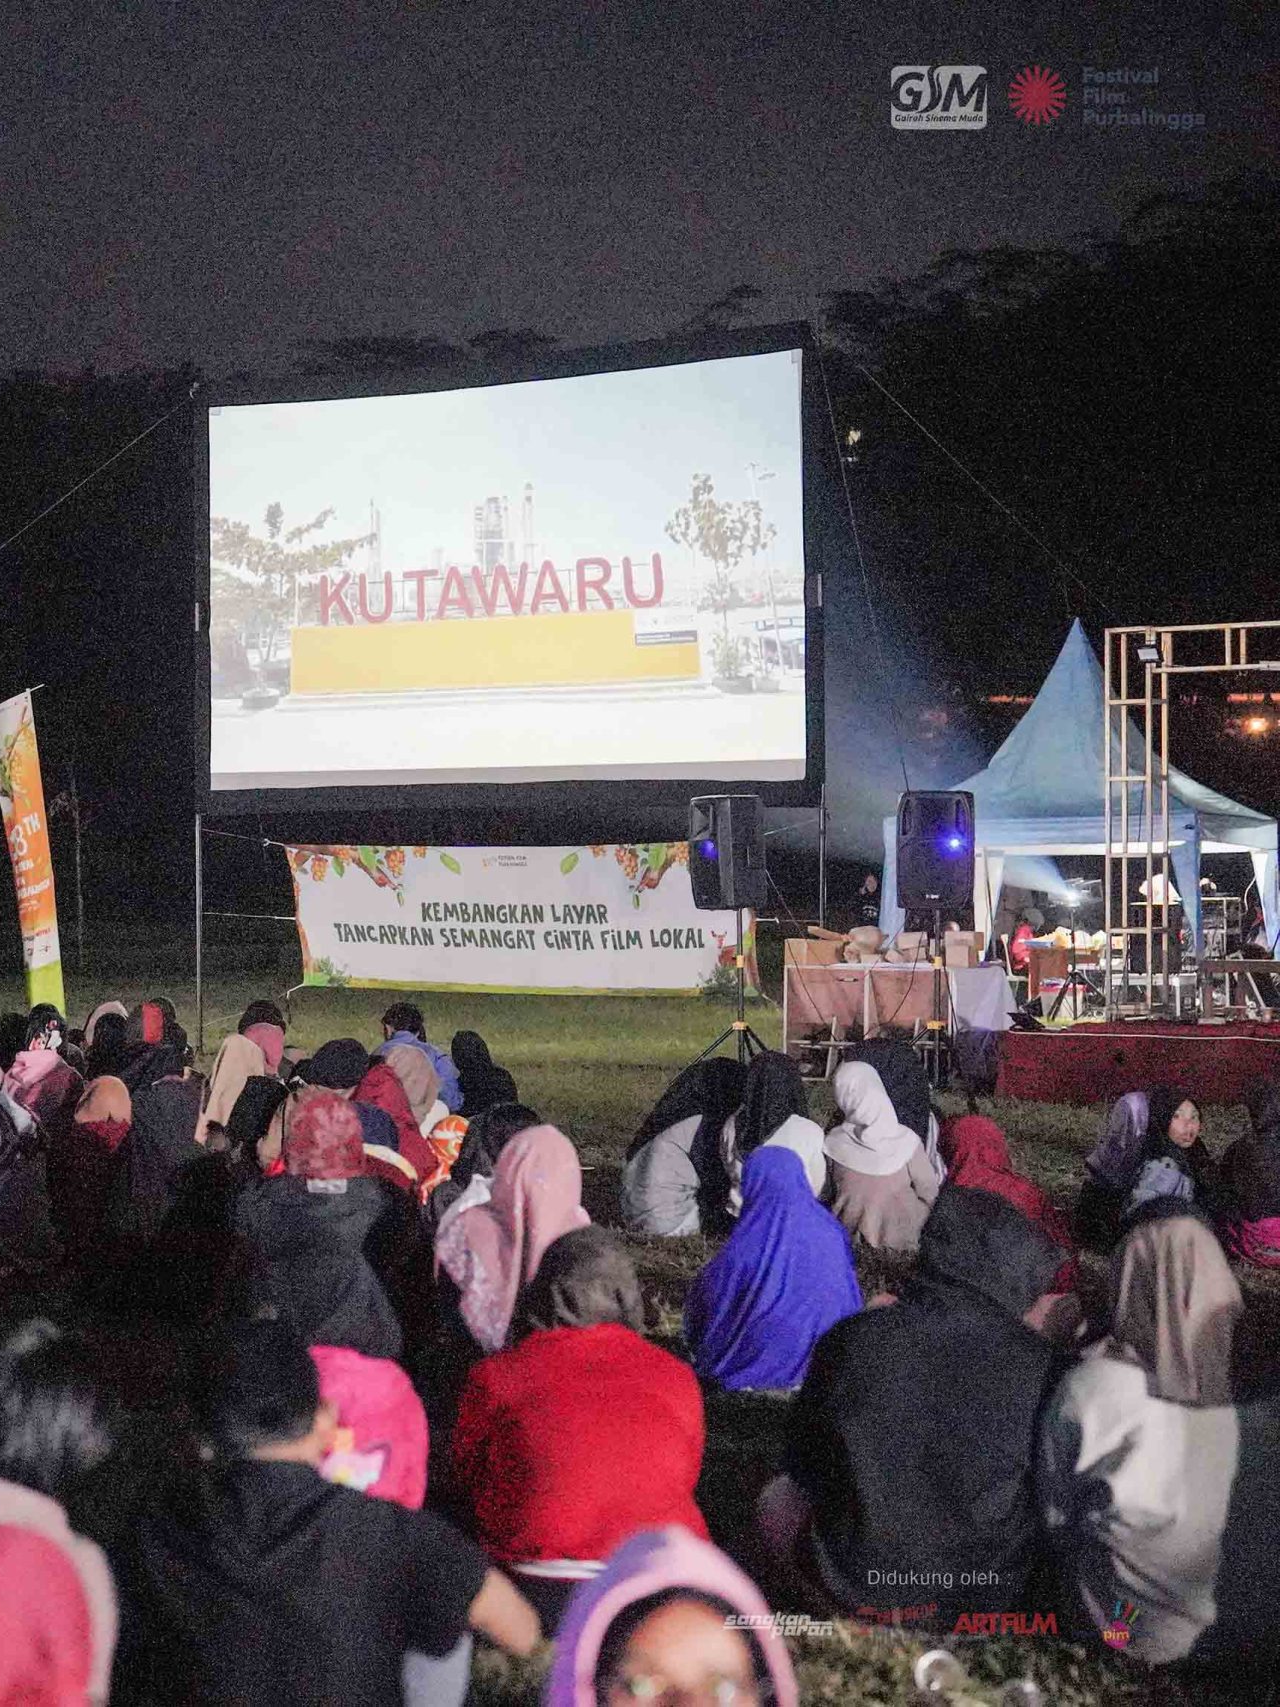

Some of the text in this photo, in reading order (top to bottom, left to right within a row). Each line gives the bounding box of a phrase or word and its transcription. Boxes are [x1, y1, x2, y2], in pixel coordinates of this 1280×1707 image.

[421, 902, 609, 925] KEMBANGKAN LAYAR
[333, 922, 435, 946] TANCAPKAN
[439, 928, 536, 950] SEMANGAT
[649, 928, 706, 949] LOKAL
